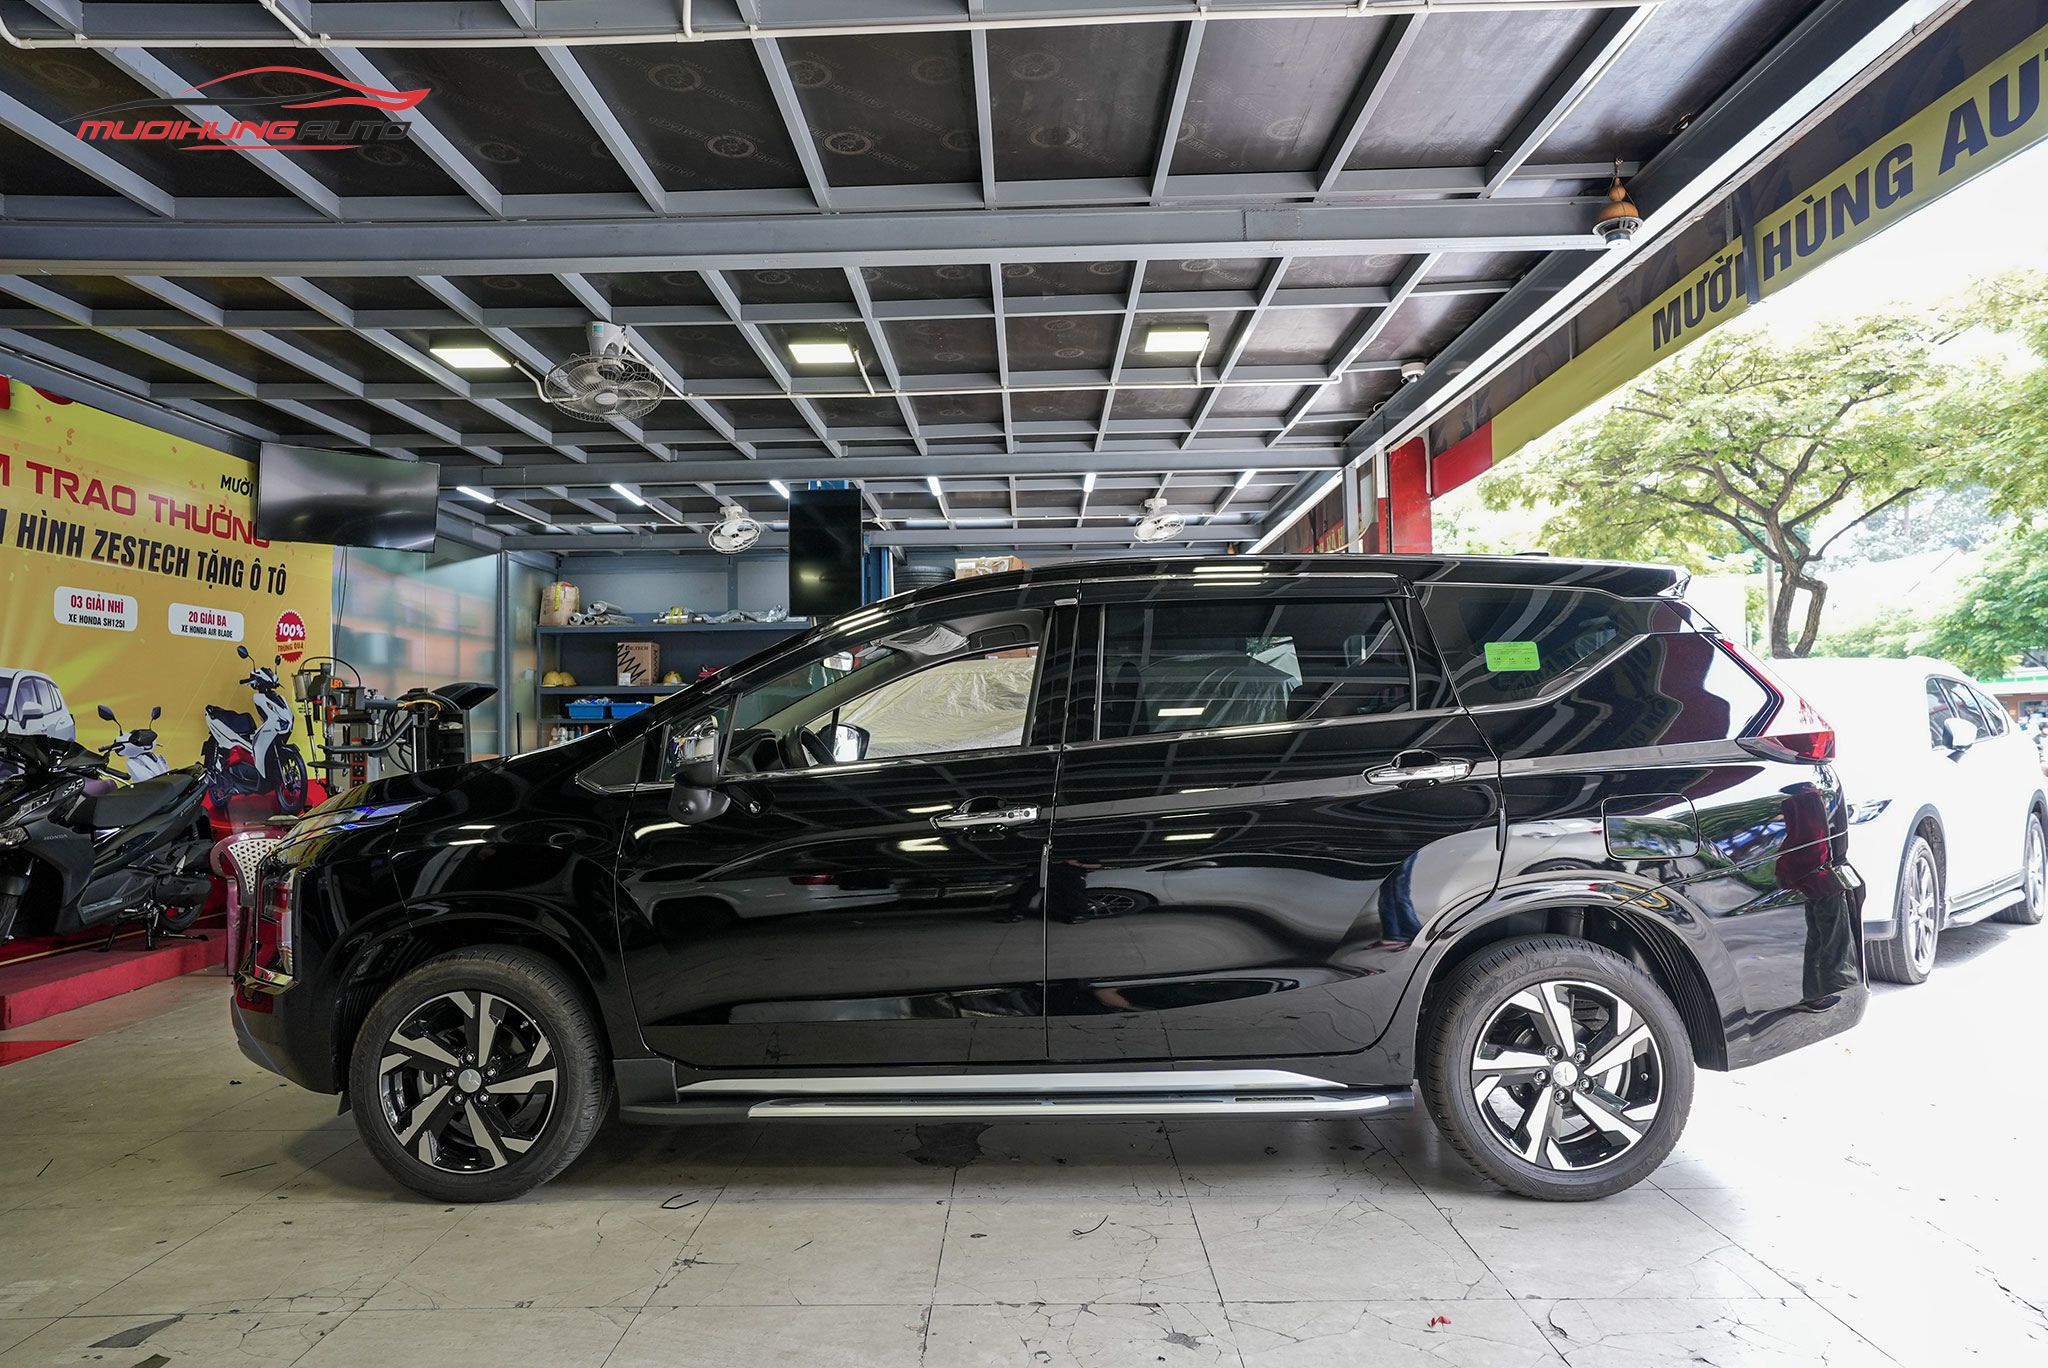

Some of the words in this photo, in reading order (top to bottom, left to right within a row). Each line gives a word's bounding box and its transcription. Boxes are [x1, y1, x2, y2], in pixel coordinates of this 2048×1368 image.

[1762, 143, 1914, 282] HÙNG
[1938, 47, 2048, 177] AU
[26, 460, 137, 517] TRAO
[220, 474, 254, 497] MƯỜI
[16, 508, 86, 558] HÌNH
[91, 528, 190, 578] ZESTECH
[197, 548, 245, 590] TẶNG
[249, 558, 262, 592] Ô
[267, 563, 287, 596] TÔ
[70, 594, 83, 609] 03
[86, 593, 105, 612] GIẢI
[68, 613, 78, 623] XE
[78, 614, 102, 626] HONDA
[188, 610, 199, 623] 20
[216, 614, 227, 627] BA
[181, 624, 189, 633] XE
[189, 625, 207, 635] HONDA
[217, 628, 233, 638] BLADE
[279, 622, 304, 638] 100%
[43, 833, 68, 841] HONDA
